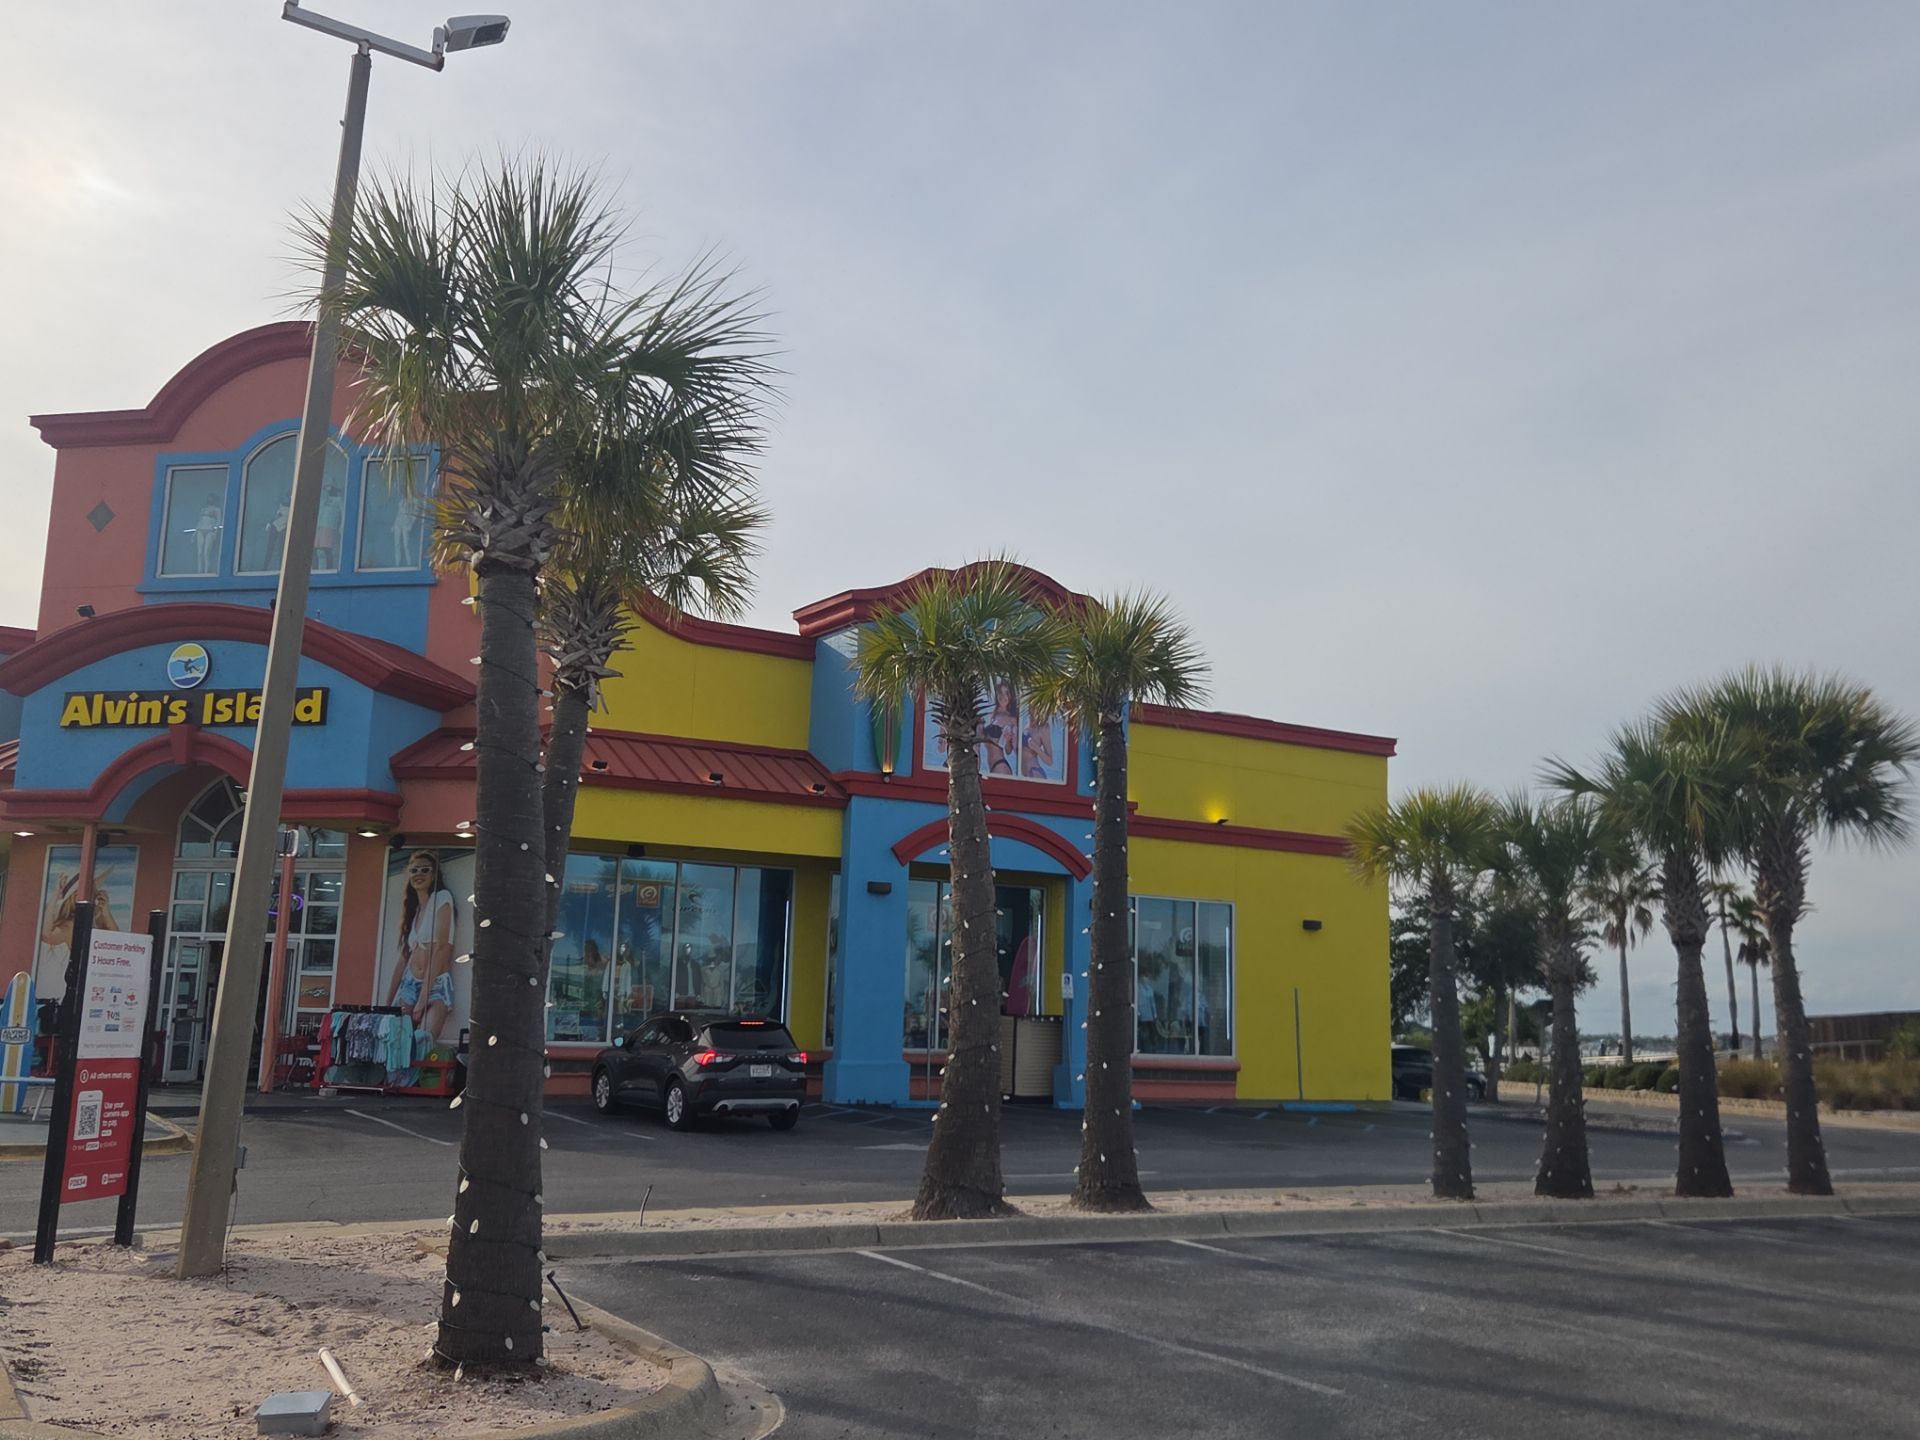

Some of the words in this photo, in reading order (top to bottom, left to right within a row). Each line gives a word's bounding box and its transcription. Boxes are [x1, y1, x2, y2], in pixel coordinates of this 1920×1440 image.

[60, 693, 188, 727] Alvin's
[202, 689, 323, 725] Islad
[94, 940, 123, 951] Customer
[124, 943, 146, 955] Parking
[92, 955, 97, 964] 3
[97, 956, 115, 966] Hours
[89, 1072, 97, 1080] All
